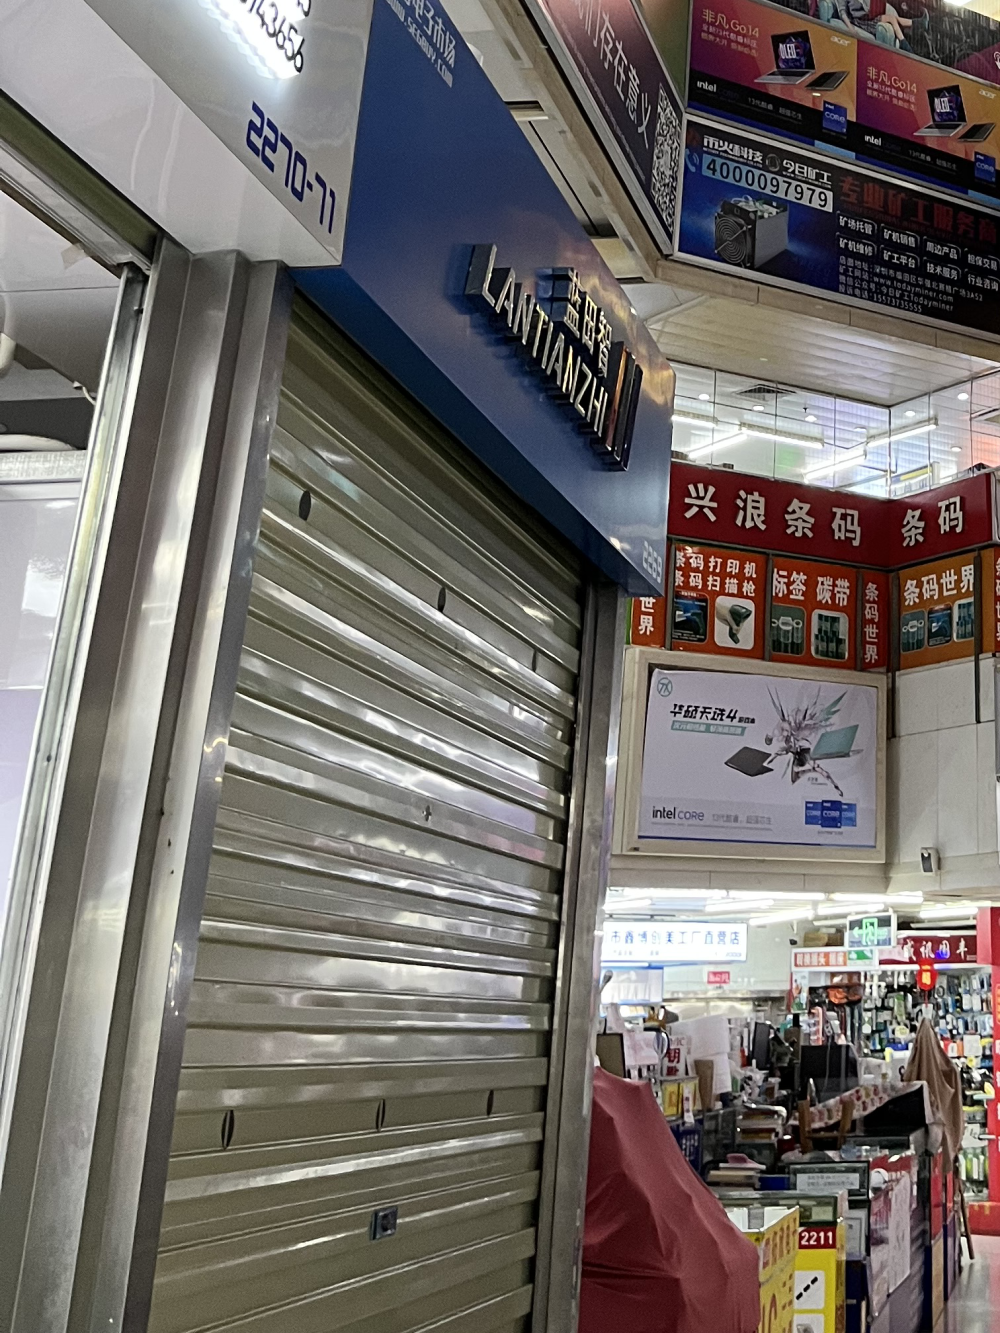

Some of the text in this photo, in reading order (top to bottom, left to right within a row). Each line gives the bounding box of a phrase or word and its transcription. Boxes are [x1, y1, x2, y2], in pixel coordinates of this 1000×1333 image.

[830, 36, 851, 47] acer
[696, 80, 717, 93] intel
[864, 135, 882, 146] intel
[246, 100, 336, 236] 2270-71
[706, 158, 828, 208] 4000097979
[839, 175, 997, 244] 专业矿工服务商
[838, 215, 873, 236] 矿场托管
[883, 228, 917, 248] 矿机销售
[925, 241, 958, 260] 周边产品
[967, 253, 998, 271] 担保交易
[838, 237, 999, 292] 矿机维修 矿工平台 技术服务 行业咨询
[481, 242, 609, 439] LANTIANZHI
[683, 482, 964, 548] 兴浪条码 条码
[675, 550, 757, 579] 条码打印机
[675, 569, 756, 598] 条码扫描枪
[772, 568, 850, 607] 标签 碳带
[902, 564, 975, 607] 条码世界
[638, 596, 655, 636] 世界
[864, 582, 879, 664] 条码世界
[670, 703, 739, 723] 华硕天选4
[652, 805, 676, 820] intel
[604, 930, 740, 946] 市鑫博创美工厂直营店
[800, 1231, 834, 1246] 2211
